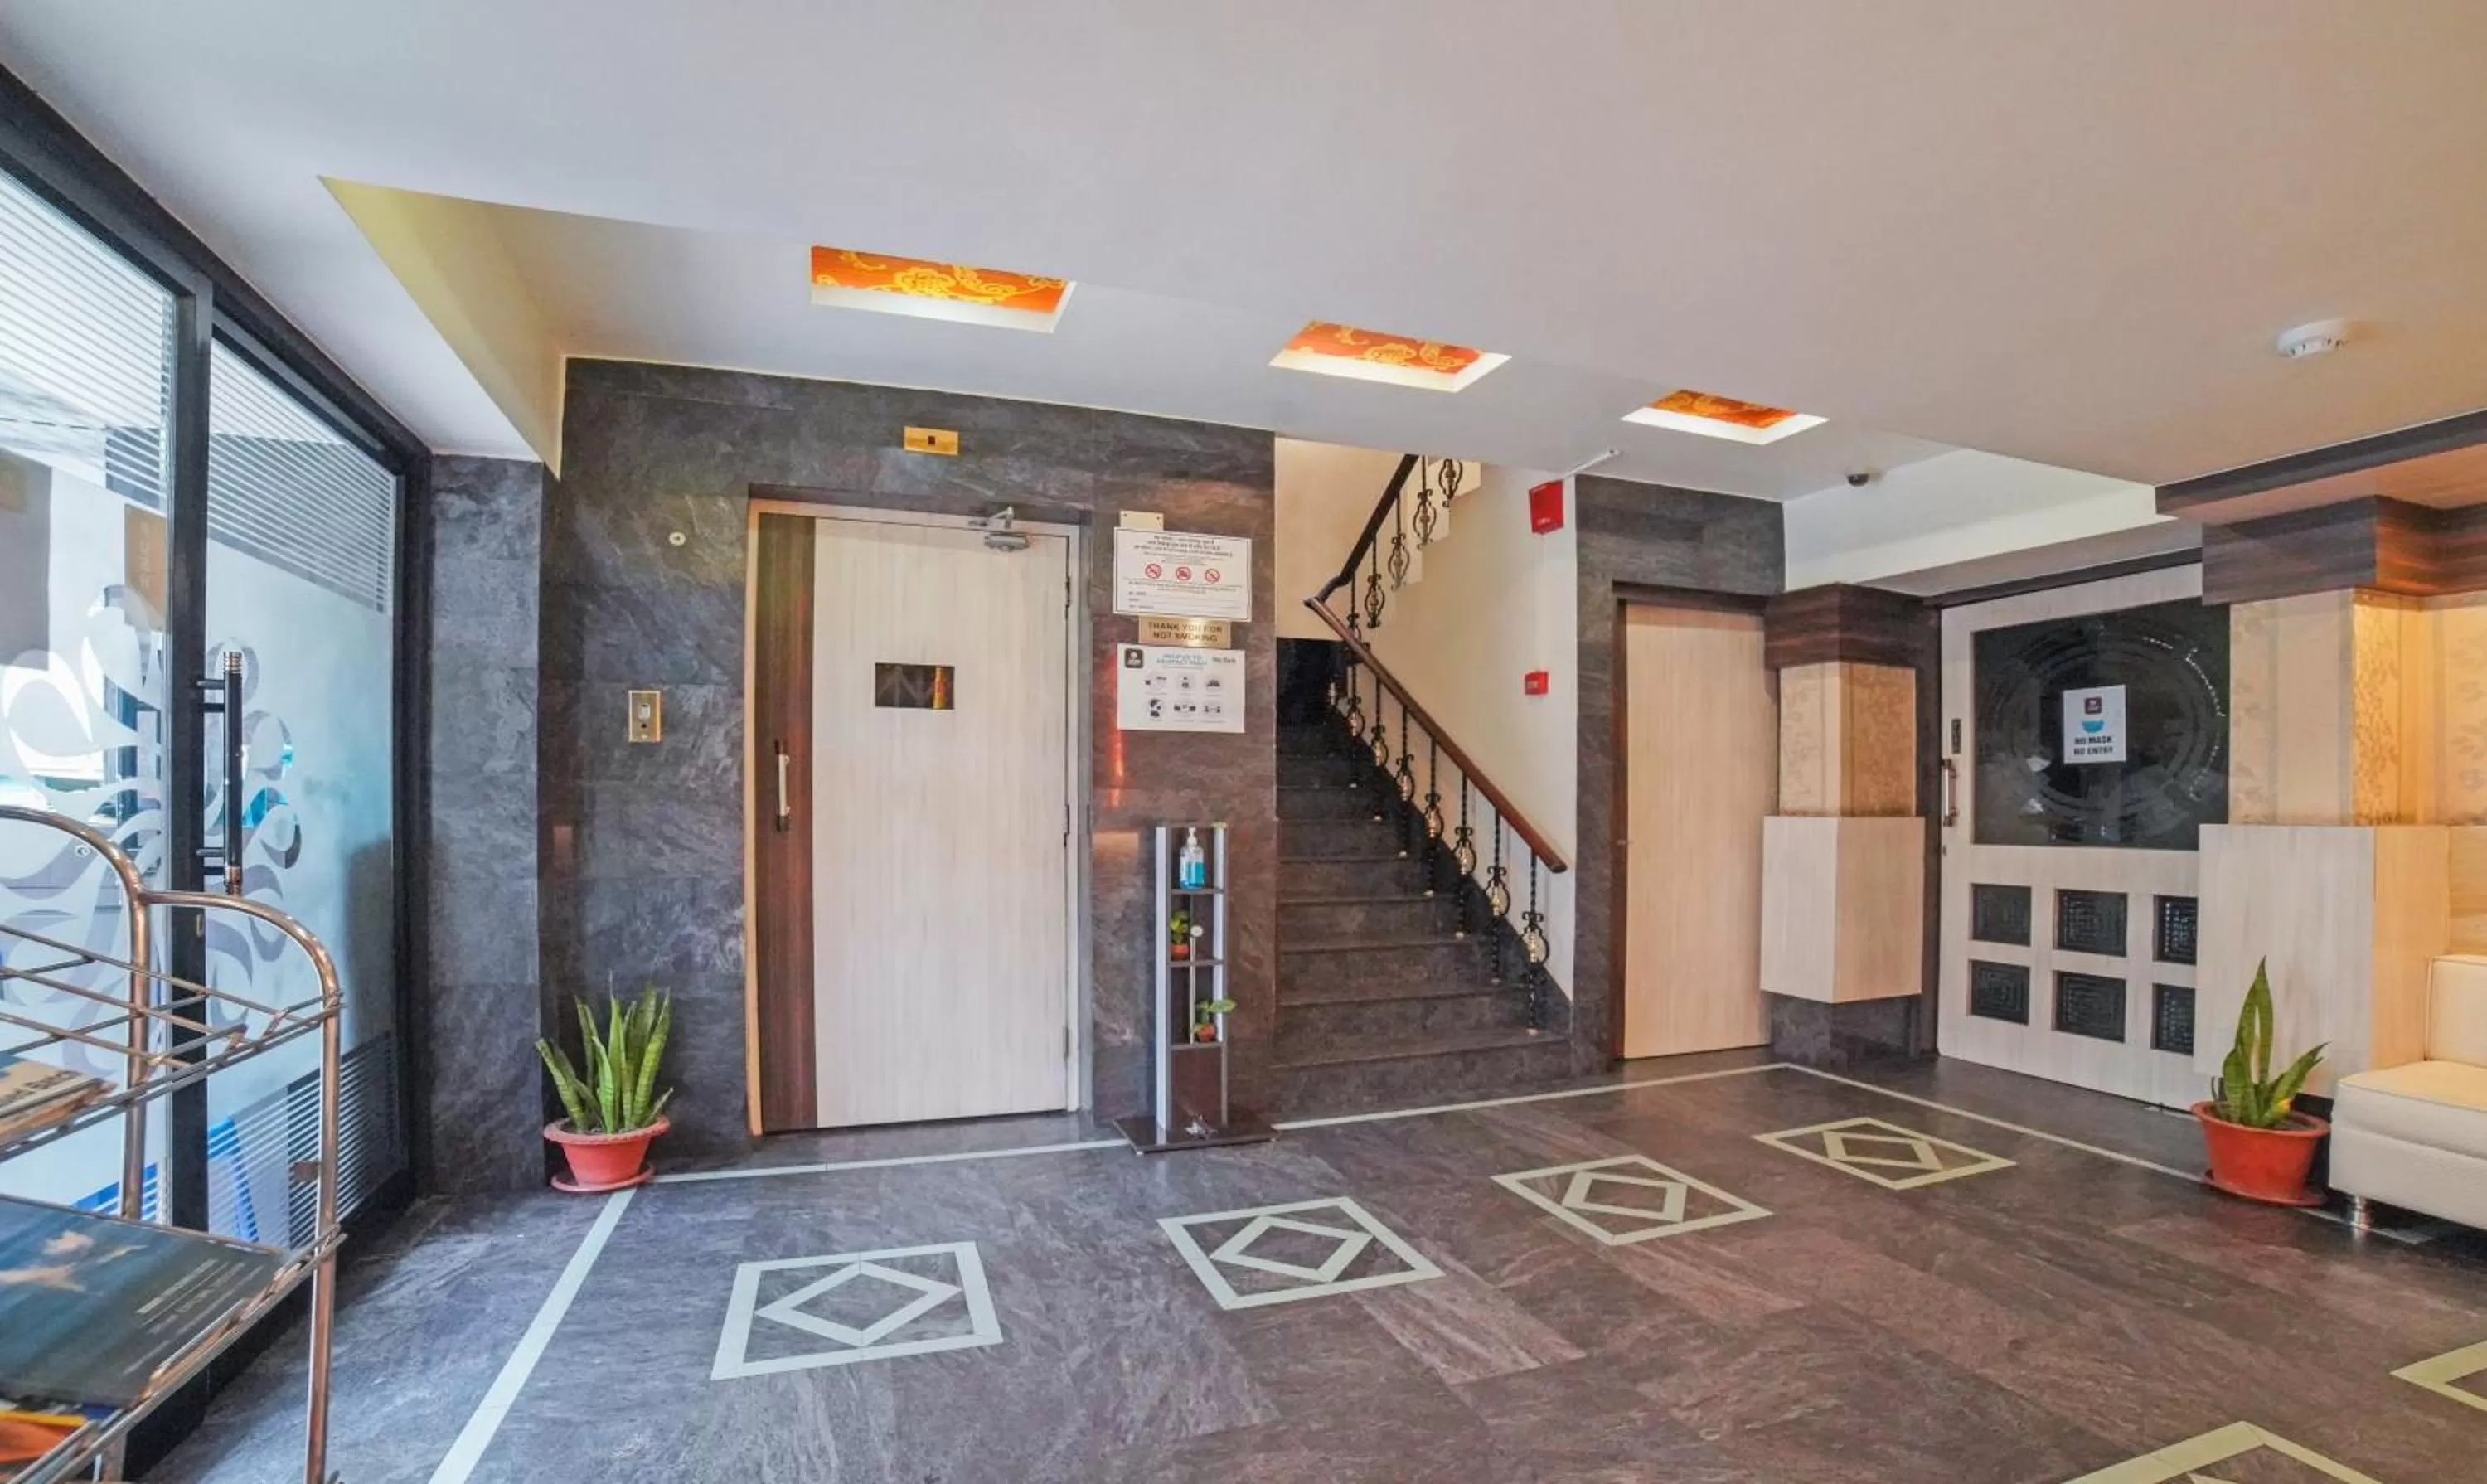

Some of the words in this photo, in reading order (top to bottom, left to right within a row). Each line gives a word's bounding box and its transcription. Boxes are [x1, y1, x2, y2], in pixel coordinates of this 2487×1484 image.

[1147, 622, 1179, 631] THANK
[1182, 623, 1201, 632] YOU
[1203, 624, 1223, 633] FOR
[1153, 631, 1171, 640] NOT
[1174, 632, 1218, 643] SMOKING
[2088, 735, 2112, 744] MASK
[2087, 746, 2114, 755] ENTRY
